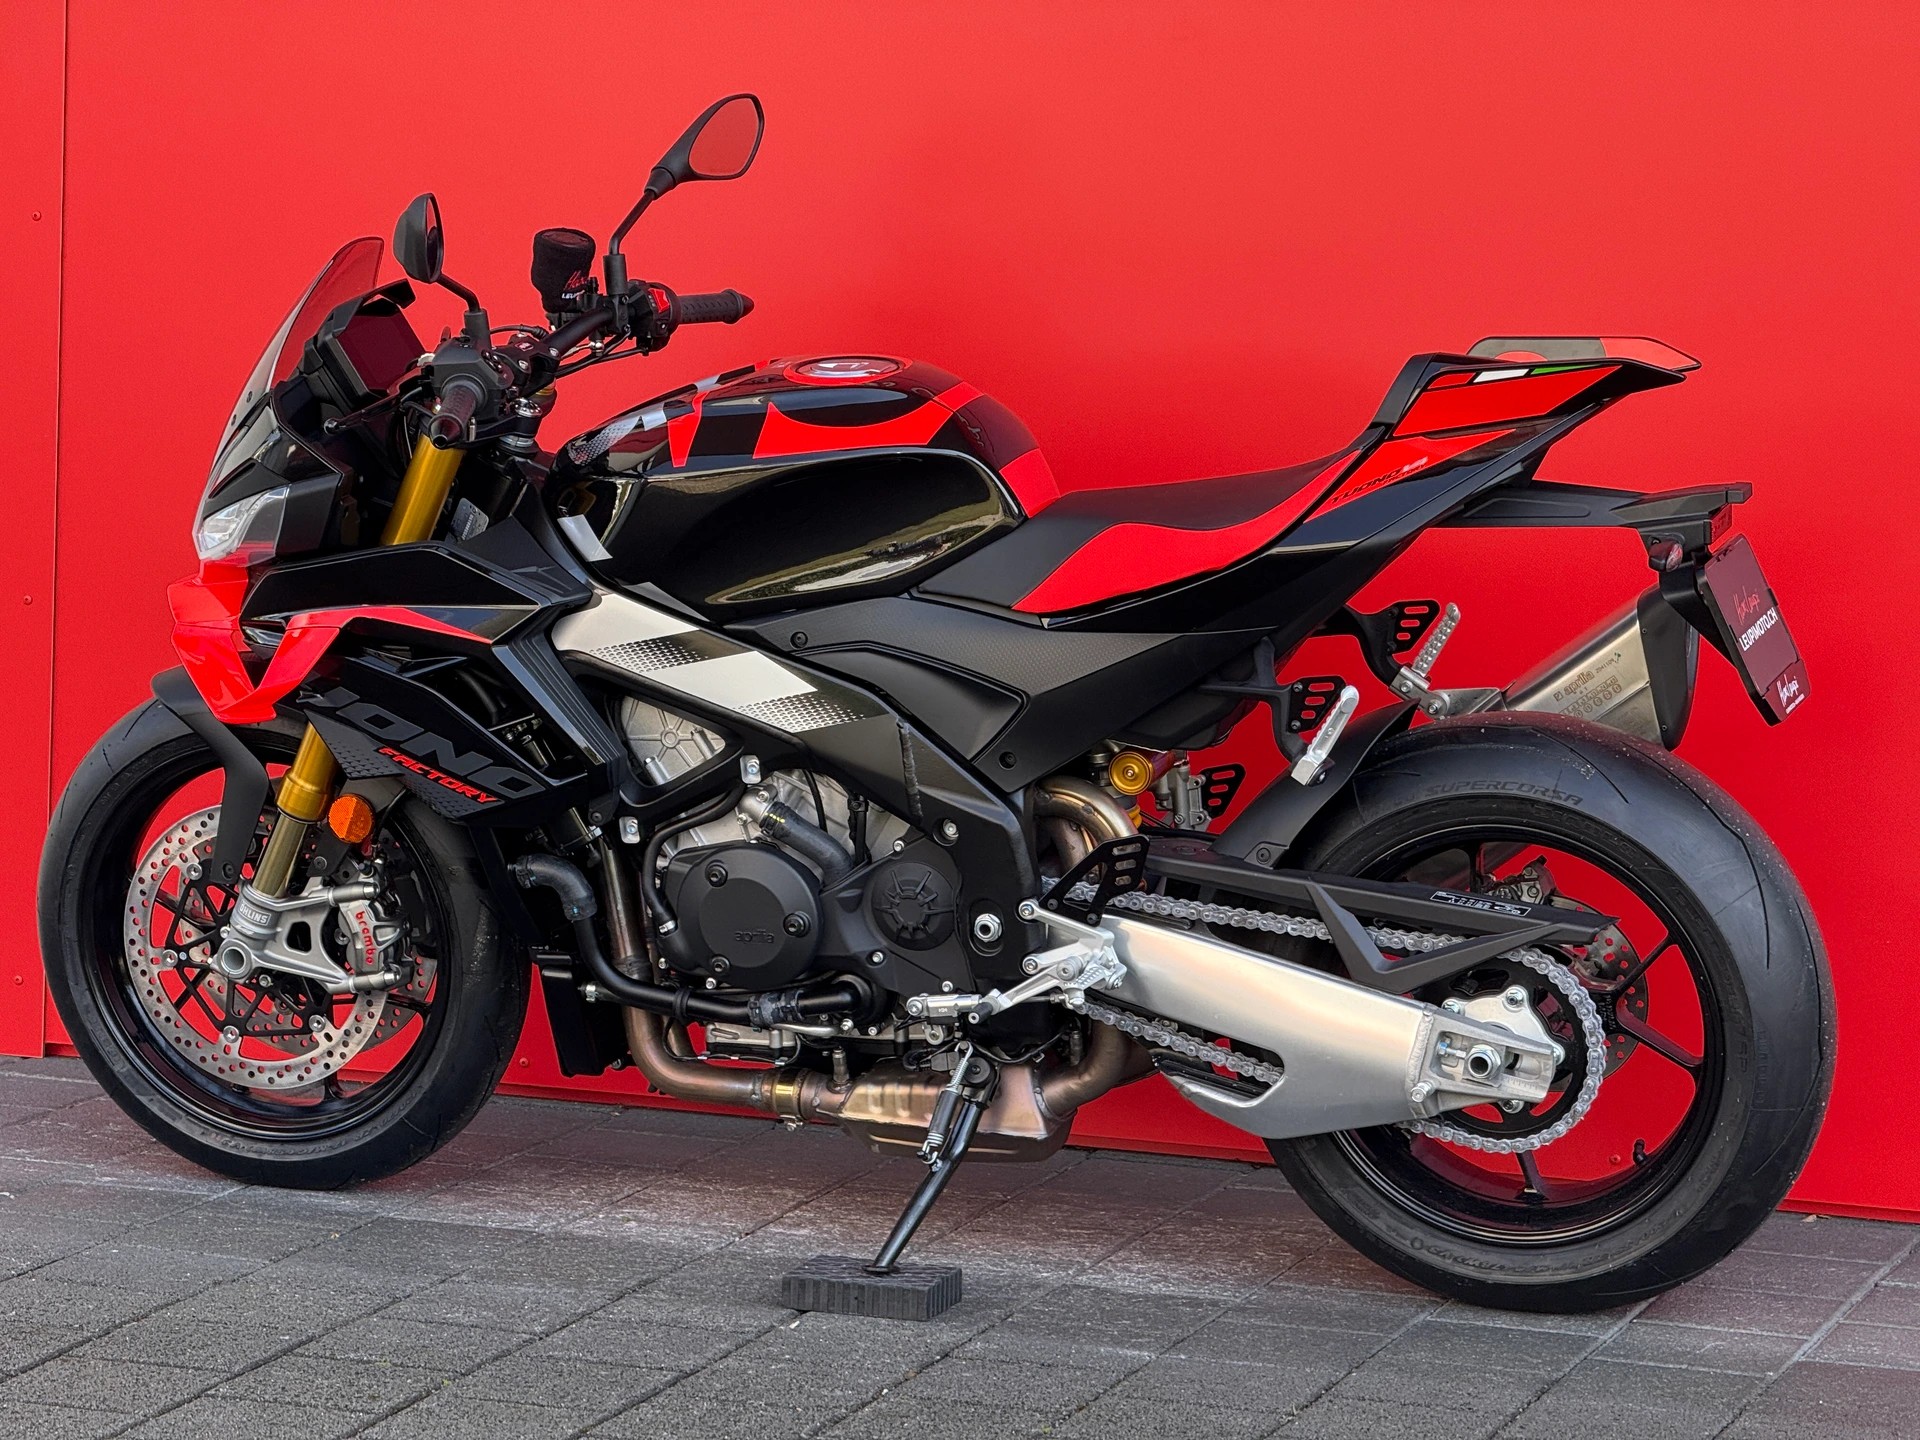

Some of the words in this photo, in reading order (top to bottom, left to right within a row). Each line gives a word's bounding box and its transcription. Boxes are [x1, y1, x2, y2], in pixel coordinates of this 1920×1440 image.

[1332, 467, 1402, 503] TUONO
[1738, 607, 1779, 651] LEUPIMOTO.CH
[1563, 670, 1596, 695] aprilia
[378, 746, 499, 803] FACTORY
[1425, 780, 1584, 806] SUPERCORSA
[355, 910, 377, 965] brembo
[734, 928, 775, 945] aprilia
